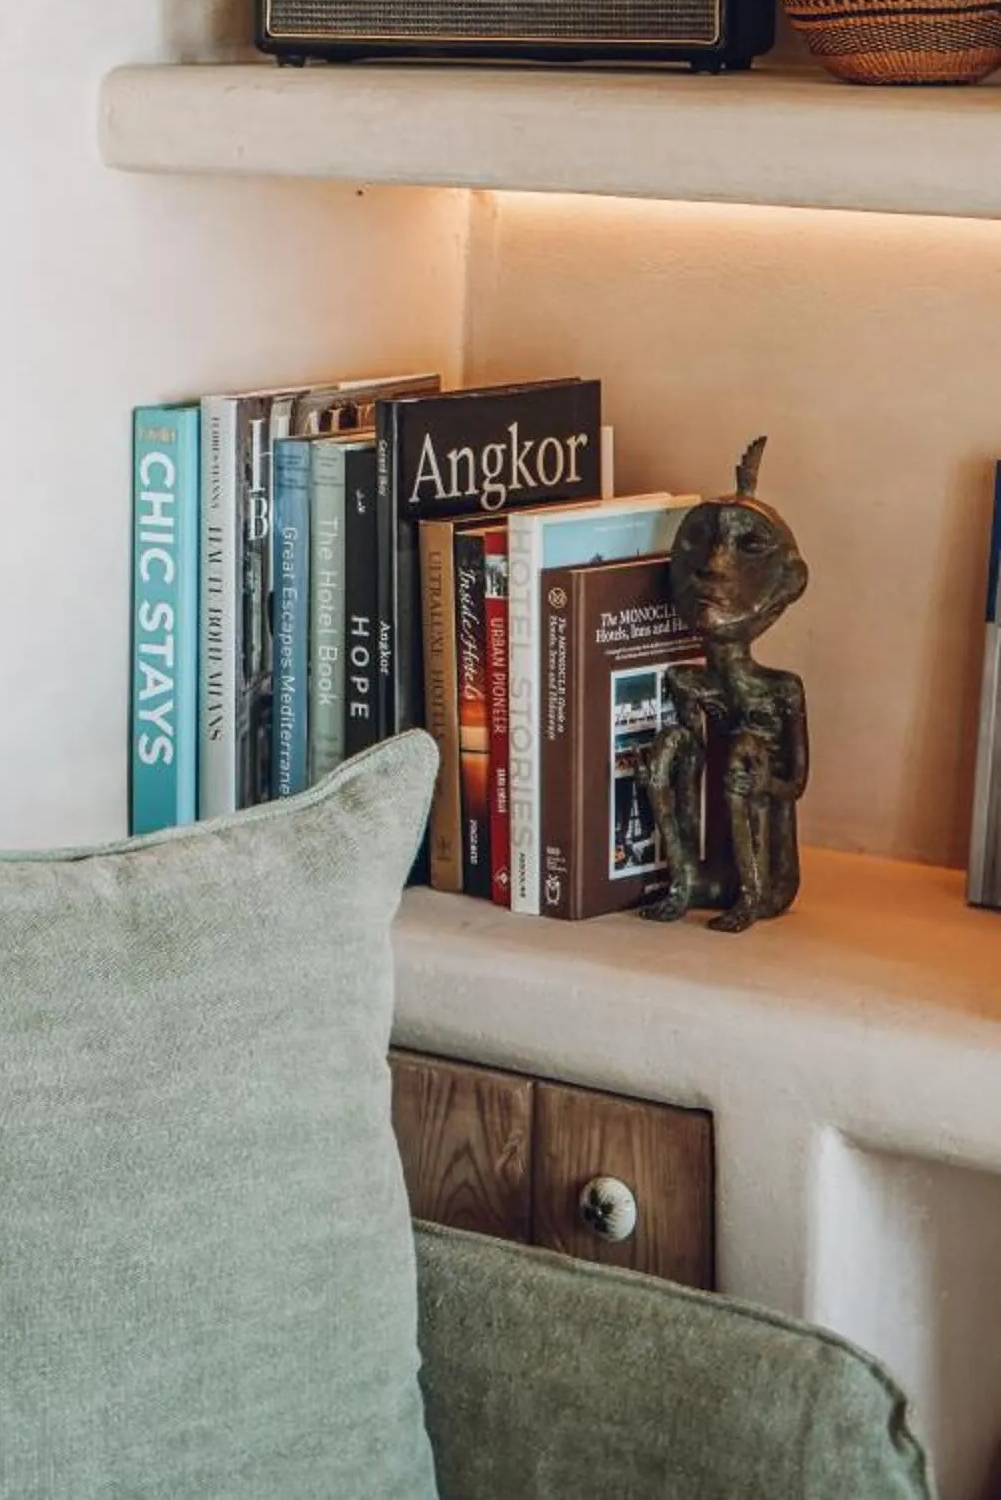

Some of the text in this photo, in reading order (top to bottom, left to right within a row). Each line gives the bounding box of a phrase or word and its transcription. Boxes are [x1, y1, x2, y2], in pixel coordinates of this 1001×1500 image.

[138, 451, 176, 586] CHIC
[408, 420, 588, 511] Angkor
[317, 516, 340, 706] The Hotel Book
[378, 620, 392, 676] Angkor
[427, 551, 445, 659] ULTRALUXE
[458, 567, 480, 627] Inside
[600, 612, 618, 627] The
[138, 602, 175, 765] STAYS
[207, 607, 224, 741] BOHEMIANS
[278, 526, 298, 803] Great Escapes Mediterrane
[350, 614, 371, 719] HOPE
[490, 616, 508, 735] URBAN PIONEER
[509, 528, 535, 848] HOTEL STORIES
